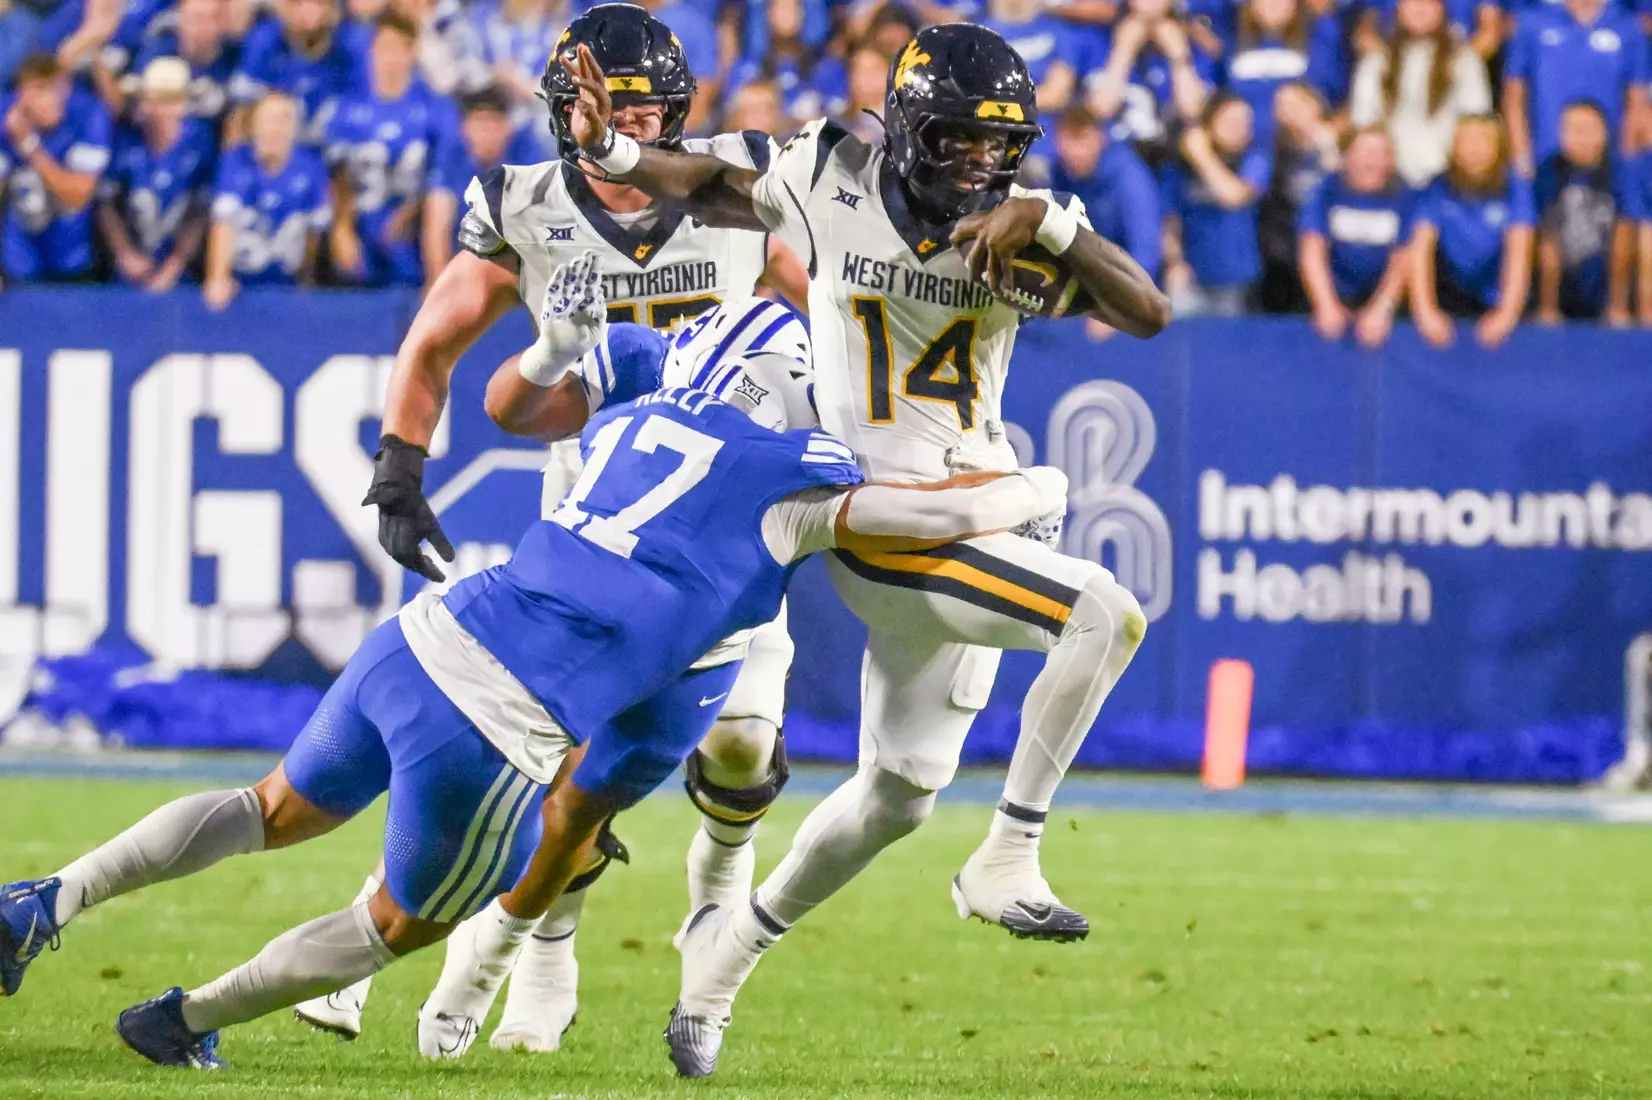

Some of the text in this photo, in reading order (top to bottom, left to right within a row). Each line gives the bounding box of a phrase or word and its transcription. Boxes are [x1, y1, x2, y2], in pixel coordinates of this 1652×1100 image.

[600, 260, 717, 298] ST VIRGINIA
[842, 251, 900, 292] WEST
[851, 295, 981, 432] 14
[553, 413, 726, 559] 17
[1199, 467, 1652, 552] Intermounta
[1197, 546, 1432, 625] Health
